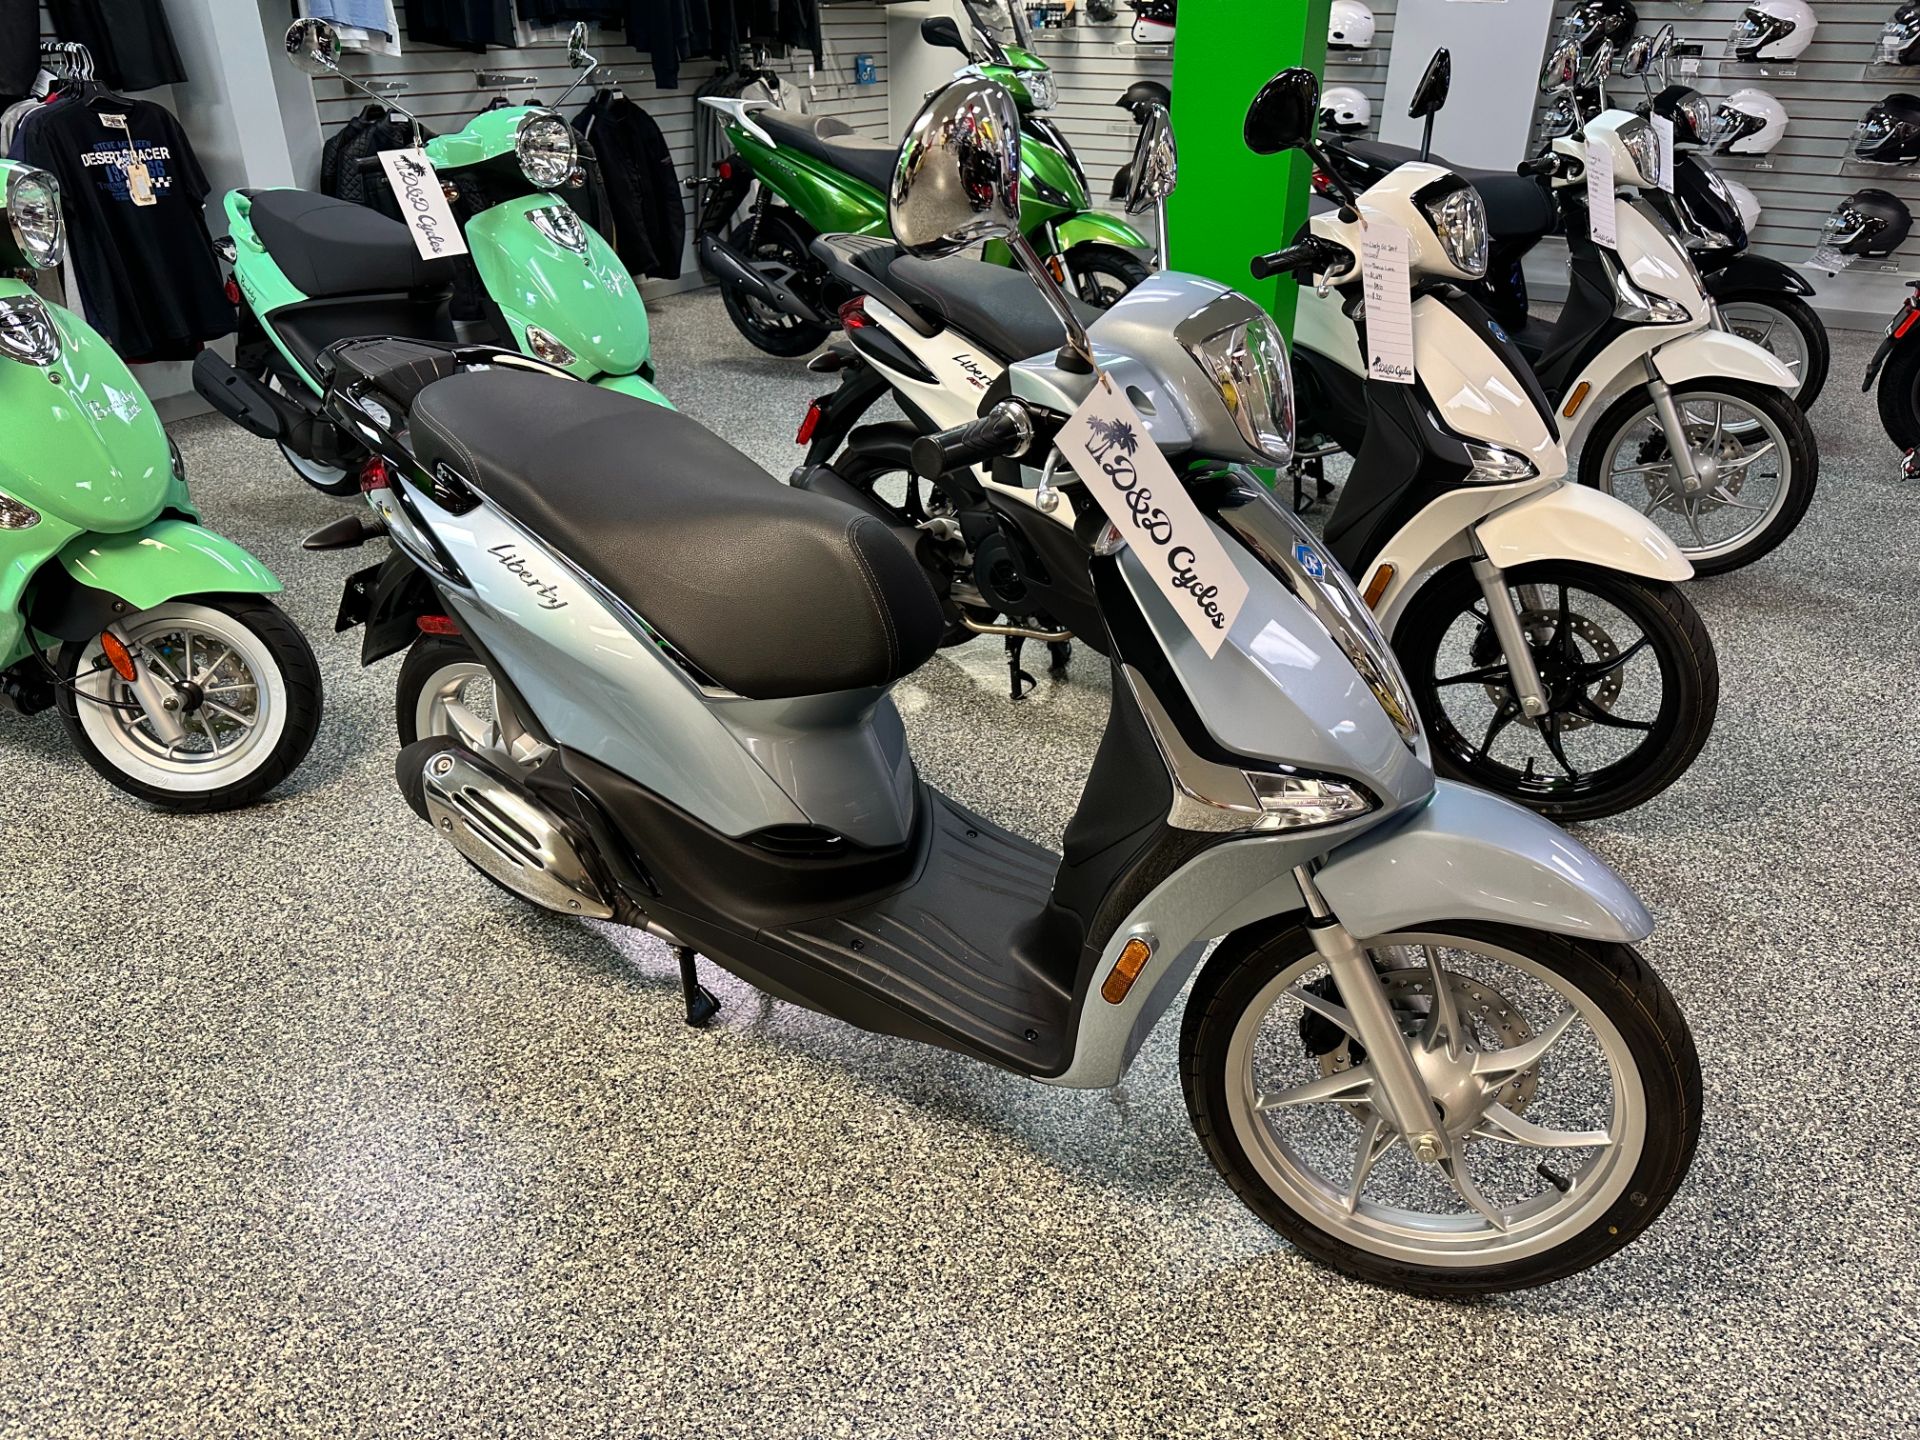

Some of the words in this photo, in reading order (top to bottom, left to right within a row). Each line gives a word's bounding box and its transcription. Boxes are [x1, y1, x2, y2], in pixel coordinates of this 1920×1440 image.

[399, 171, 430, 212] D&D
[416, 214, 445, 254] Cycles
[952, 354, 994, 386] Liber
[1395, 365, 1412, 378] Cycles
[1102, 455, 1173, 545] D&D
[1167, 546, 1225, 630] Cycles
[487, 544, 568, 610] Liberty
